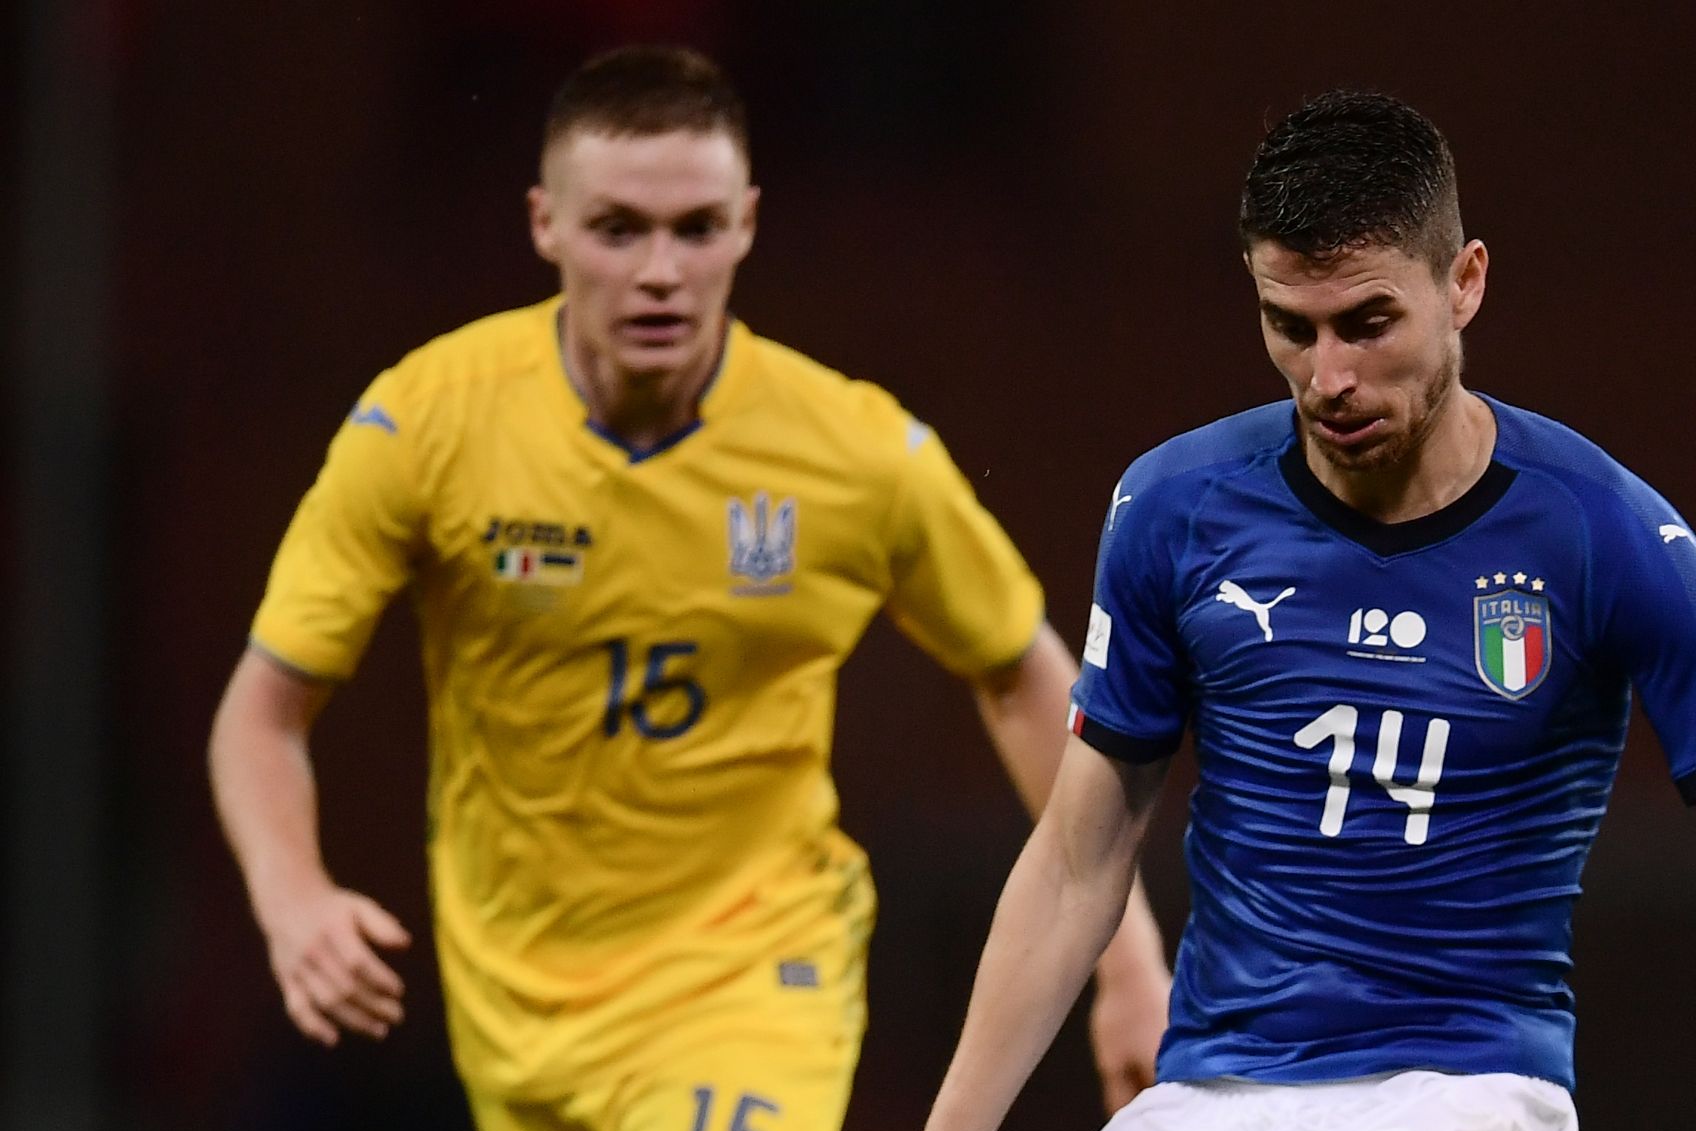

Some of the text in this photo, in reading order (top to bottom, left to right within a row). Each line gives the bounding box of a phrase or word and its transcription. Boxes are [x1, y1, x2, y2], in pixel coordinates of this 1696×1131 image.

[1347, 608, 1427, 649] 120
[1481, 600, 1542, 617] ITALIA
[602, 638, 708, 740] 15
[1294, 703, 1451, 845] 14
